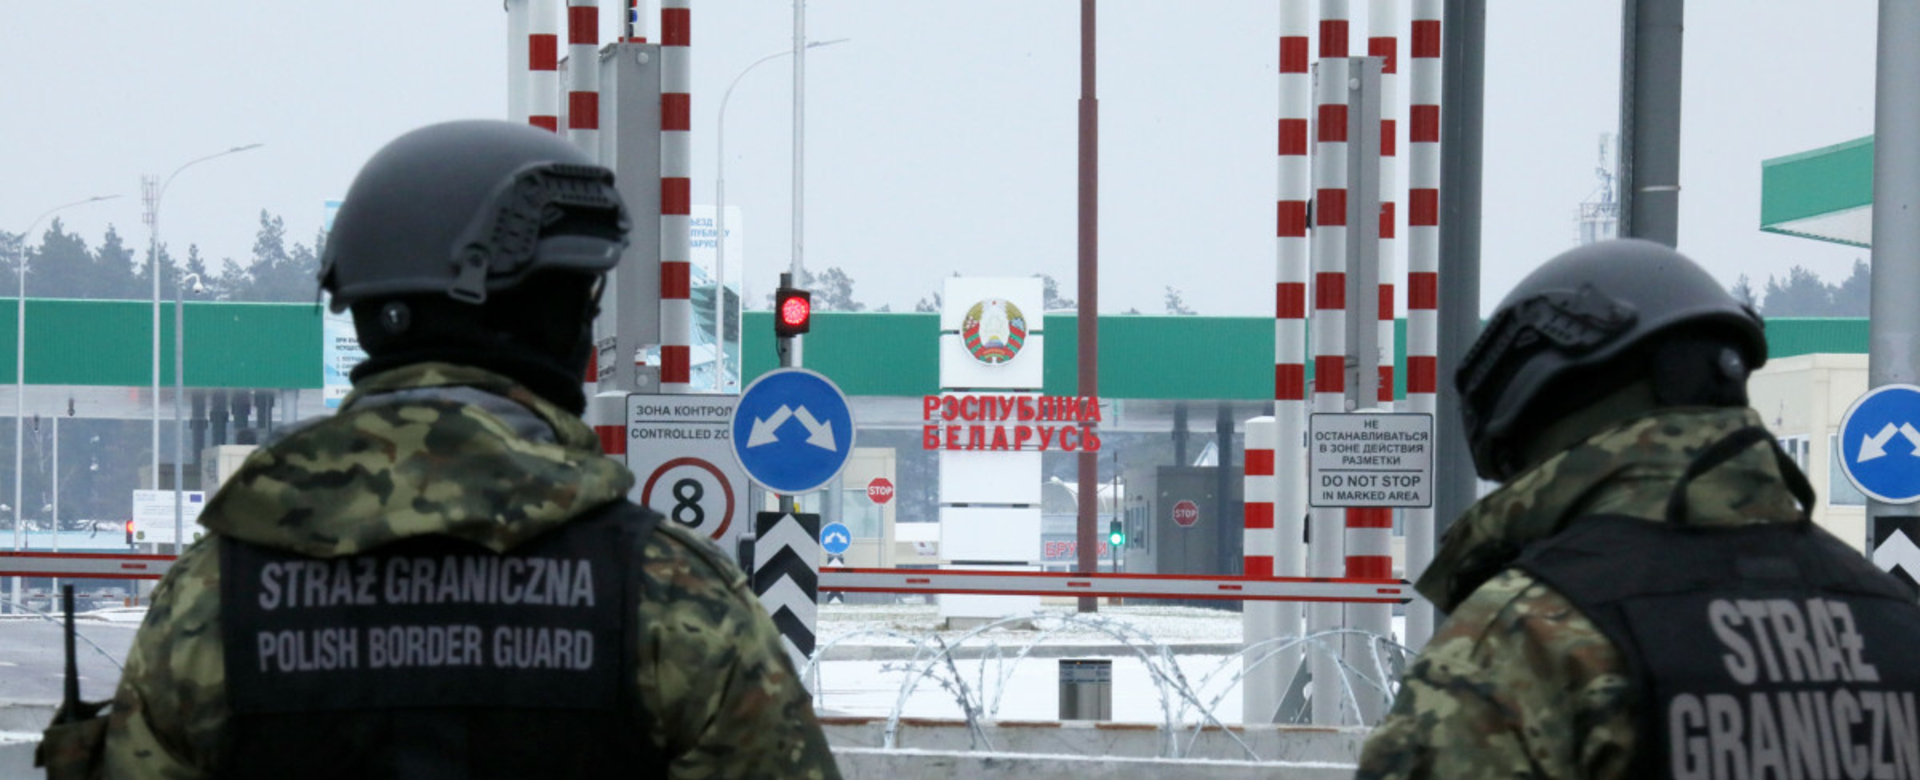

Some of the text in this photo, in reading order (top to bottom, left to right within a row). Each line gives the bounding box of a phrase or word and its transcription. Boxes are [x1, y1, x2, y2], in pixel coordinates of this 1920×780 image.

[636, 405, 671, 416] ЗОНА
[923, 395, 1101, 422] РЭСПУБЛІКА
[1364, 419, 1379, 429] НЕ
[631, 428, 711, 439] CONTROLLED
[922, 425, 1101, 451] БЕЛАРУСЬ
[1315, 431, 1428, 441] ОСТАНАВЛИВАТЬСЯ
[1319, 443, 1423, 454] В ЗОНЕ ДЕЙСТВИЯ
[1342, 455, 1401, 465] РАЗМЕТКИ
[1322, 475, 1421, 487] DO NOT STOP
[869, 486, 893, 495] STOP
[1322, 491, 1420, 501] IN MARKED AREA
[672, 478, 704, 529] 8
[1175, 509, 1196, 518] STOP
[1045, 541, 1107, 557] БРУИ
[385, 555, 595, 607] GRANICZNA
[258, 625, 594, 672] POLISH BORDER GUARD
